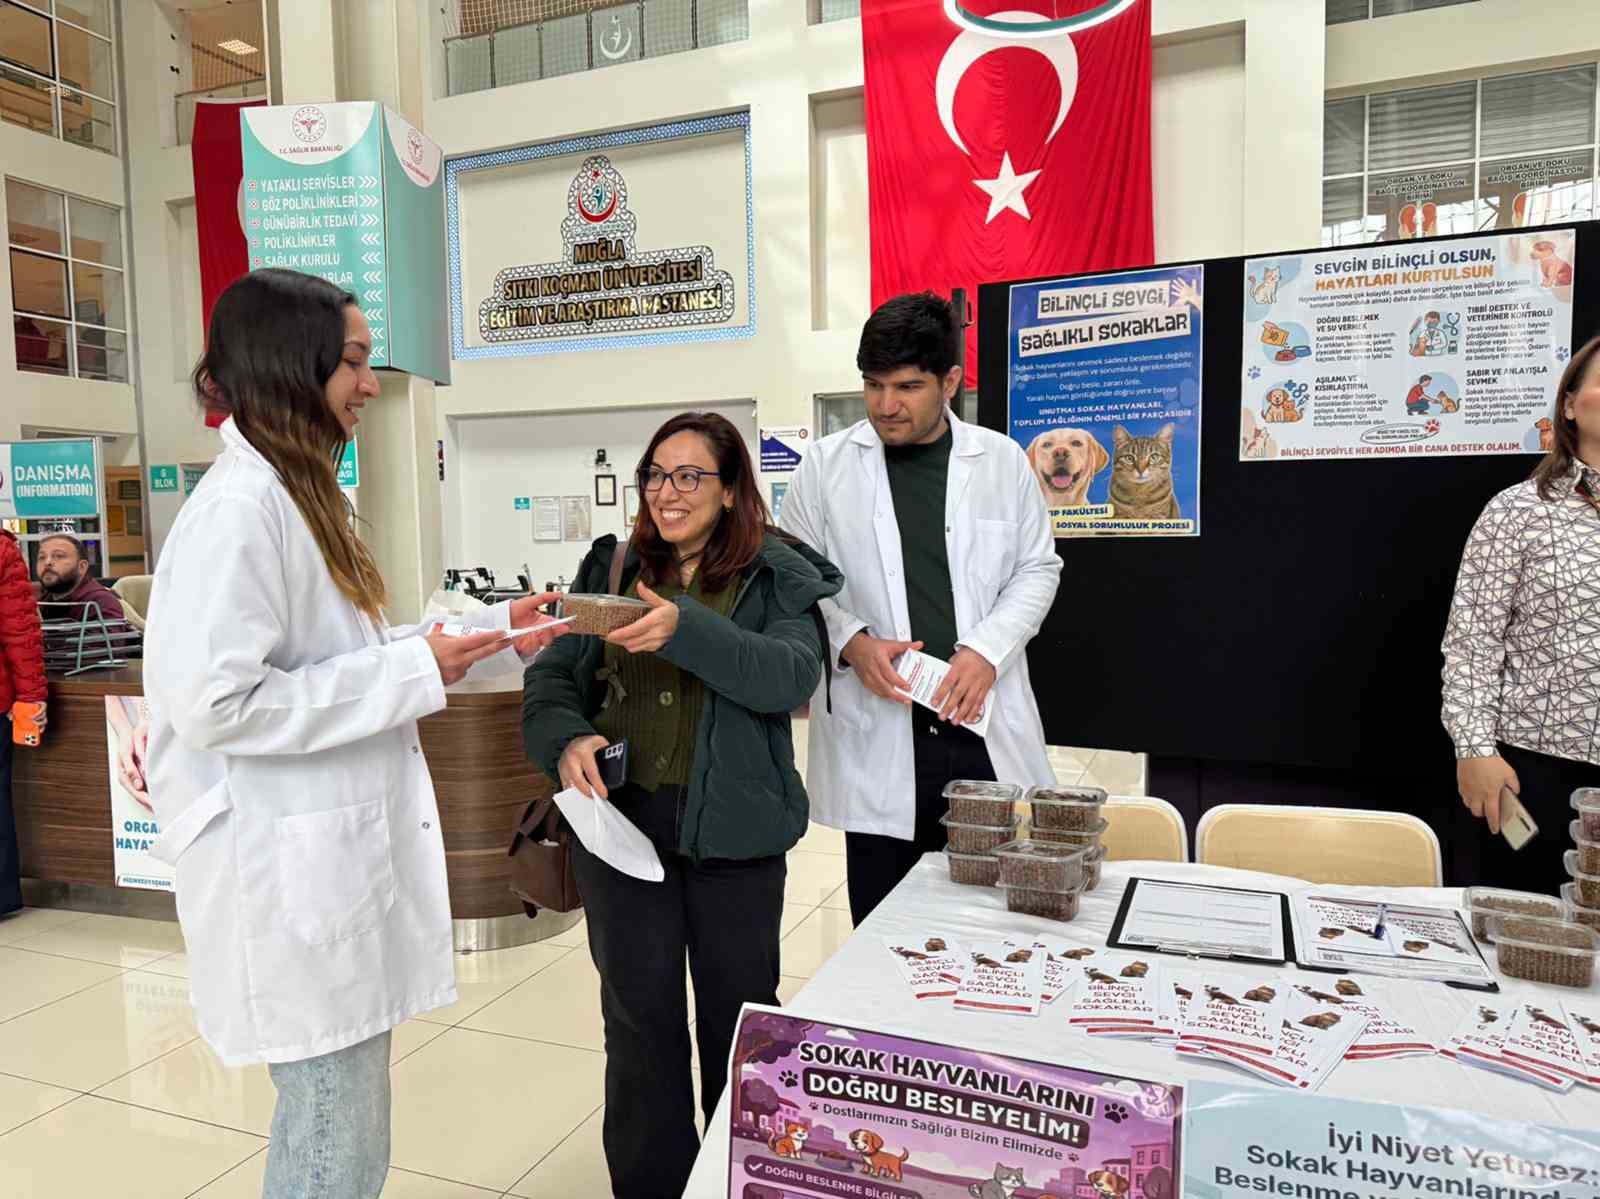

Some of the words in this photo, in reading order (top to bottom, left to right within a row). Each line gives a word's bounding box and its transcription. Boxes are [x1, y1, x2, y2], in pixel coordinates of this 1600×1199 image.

[261, 179, 301, 192] YATAKLI
[303, 174, 354, 190] SERVİSLER
[262, 197, 281, 211] GÖZ
[282, 192, 358, 210] POLİKLİNİKLERİ
[263, 215, 320, 230] GÜNÜBİRLİK
[324, 211, 358, 228] TEDAVİ
[264, 233, 336, 248] POLİKLİNİKLER
[574, 238, 625, 265] MUĞLA
[266, 252, 299, 267] SAĞLIK
[302, 253, 340, 266] KURULU
[1314, 258, 1367, 276] SEVGİN
[1371, 250, 1434, 271] BİLİNÇLİ
[1438, 248, 1496, 265] OLSUN,
[504, 275, 538, 300] SITKI
[540, 271, 600, 300] KOÇMAN
[602, 255, 702, 290] ÜNİVERSİTESİ
[1316, 274, 1398, 291] HAYATLARI
[1402, 264, 1494, 284] KURTULSUN
[489, 304, 536, 330] EĞİTİM
[538, 304, 556, 325] VE
[557, 297, 640, 328] ARAŞTIRMA
[641, 285, 722, 316] HASTANESİ
[1466, 312, 1509, 322] VETERİNER
[1511, 307, 1552, 318] KONTROLÜ
[1468, 304, 1488, 314] TIBBİ
[1489, 304, 1519, 312] DESTEK
[1521, 302, 1531, 310] VE
[1316, 316, 1340, 324] DOĞRU
[1327, 324, 1336, 332] SU
[1492, 368, 1502, 376] VE
[1504, 366, 1548, 375] ANLAYIŞLA
[1316, 376, 1346, 384] AŞILAMA
[1466, 377, 1498, 386] SEVMEK
[1076, 405, 1104, 414] SOKAK
[1014, 418, 1045, 426] TOPLUM
[1095, 412, 1126, 422] ÖNEMLİ
[1280, 446, 1313, 458] BİLİNÇLİ
[1316, 446, 1353, 456] SEVGİYLE
[1374, 445, 1406, 454] ADIMDA
[1408, 443, 1423, 452] BİR
[1425, 444, 1448, 452] CANA
[1451, 444, 1484, 452] DESTEK
[1486, 442, 1522, 450] OLALIM.
[14, 464, 92, 483] DANIŞMA
[154, 479, 174, 488] BLOK
[16, 484, 94, 498] (INFORMATION)
[1062, 506, 1108, 516] FAKÜLTESİ
[1089, 521, 1149, 529] SORUMLULUK
[1152, 520, 1190, 529] PROJESİ
[124, 821, 160, 834] ORGA
[973, 968, 1024, 978] BİLİNÇLİ
[977, 974, 1017, 984] SEVGİ
[958, 986, 1032, 998] SOKAKLAR
[966, 980, 1026, 992] SAĞLIKLI
[1088, 984, 1144, 992] BİLİNÇLİ
[1073, 1004, 1152, 1012] SOKAKLAR
[1082, 998, 1146, 1006] SAĞLIKLI
[1206, 1003, 1264, 1017] BİLİNÇLİ
[1211, 1010, 1256, 1022] SEVGİ
[1187, 1022, 1274, 1040] SOKAKLAR
[1198, 1016, 1266, 1032] SAĞLIKLI
[800, 1042, 886, 1073] SOKAK
[892, 1054, 1094, 1117] HAYVANLARINI
[809, 1070, 898, 1105] DOĞRU
[906, 1091, 1080, 1144] BESLEYELİM!
[823, 1103, 908, 1128] Dostlarımızın
[912, 1117, 958, 1140] Sağlığı
[960, 1127, 1000, 1146] Bizim
[1002, 1136, 1064, 1160] Elimizde
[1247, 1144, 1338, 1177] Sokak
[1328, 1122, 1362, 1154] İyi
[1372, 1133, 1454, 1165] Niyet
[1463, 1146, 1600, 1187] Yetmez:
[765, 1164, 803, 1181] DOĞRU
[806, 1174, 862, 1195] BESLENME
